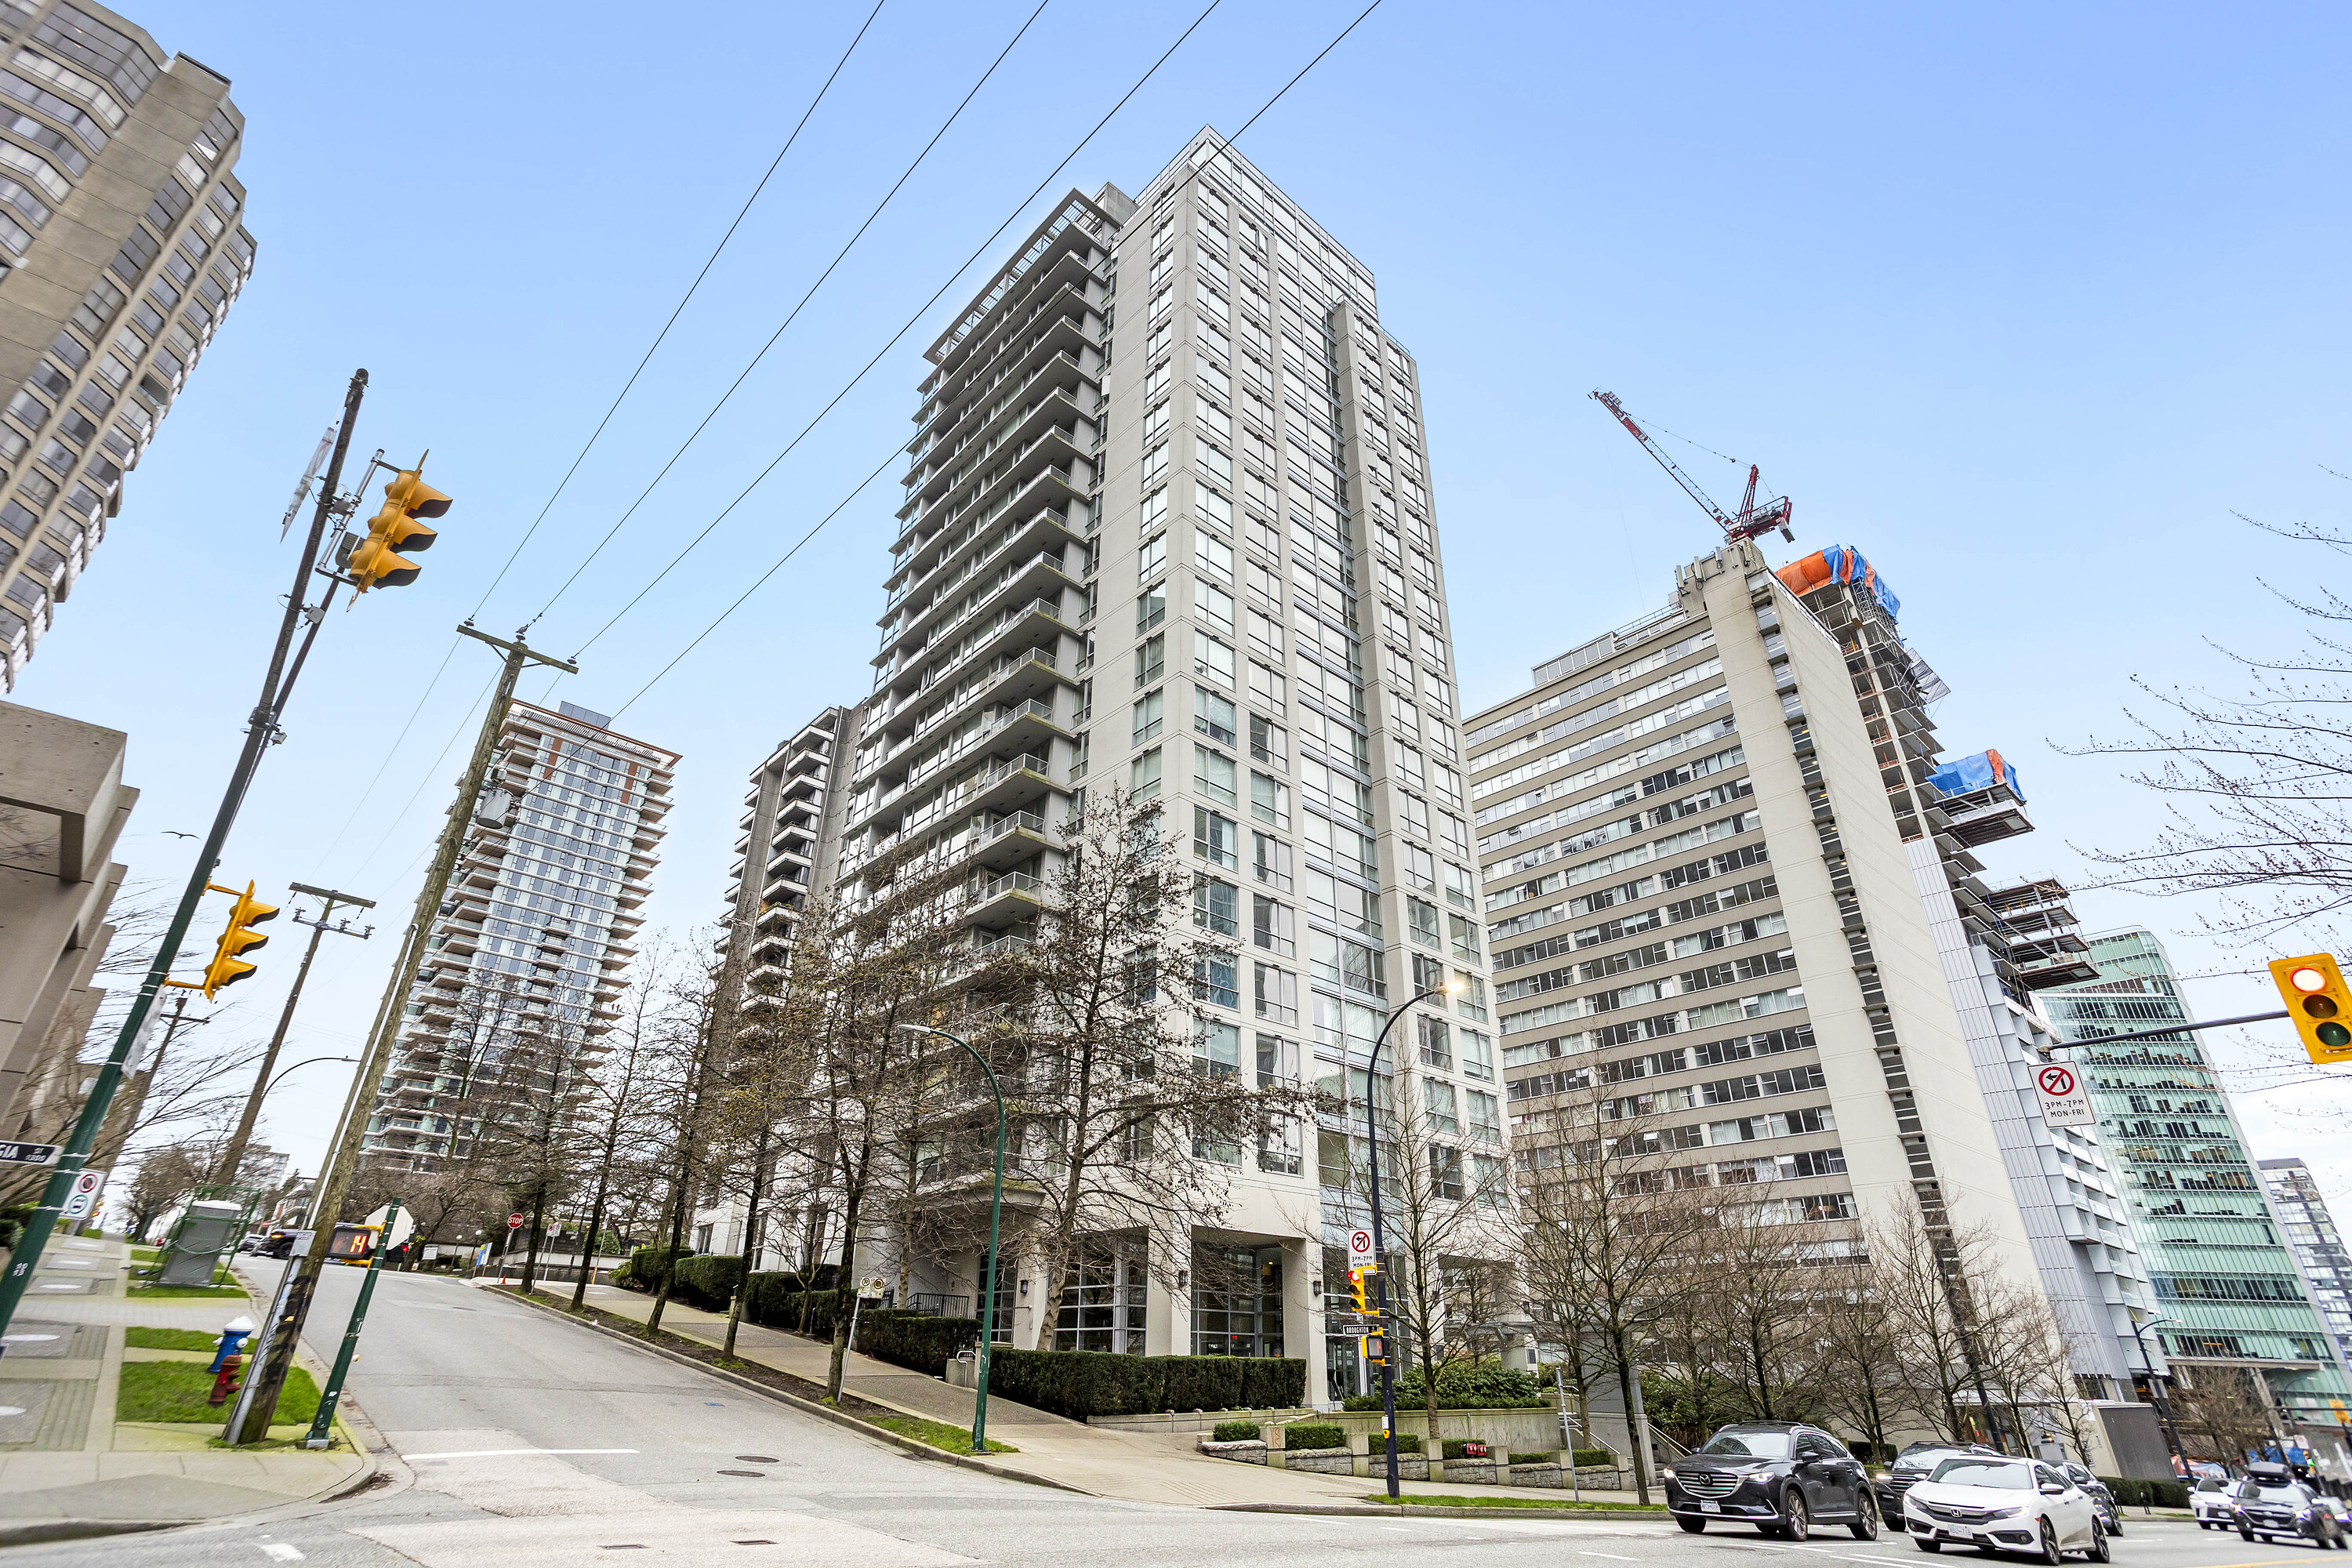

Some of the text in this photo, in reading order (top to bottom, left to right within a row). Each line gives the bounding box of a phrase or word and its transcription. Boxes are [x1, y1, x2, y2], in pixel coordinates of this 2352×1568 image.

[2045, 1099, 2084, 1110] 3PM-7PM
[2050, 1109, 2085, 1117] MON-FRI
[350, 1235, 367, 1253] 14
